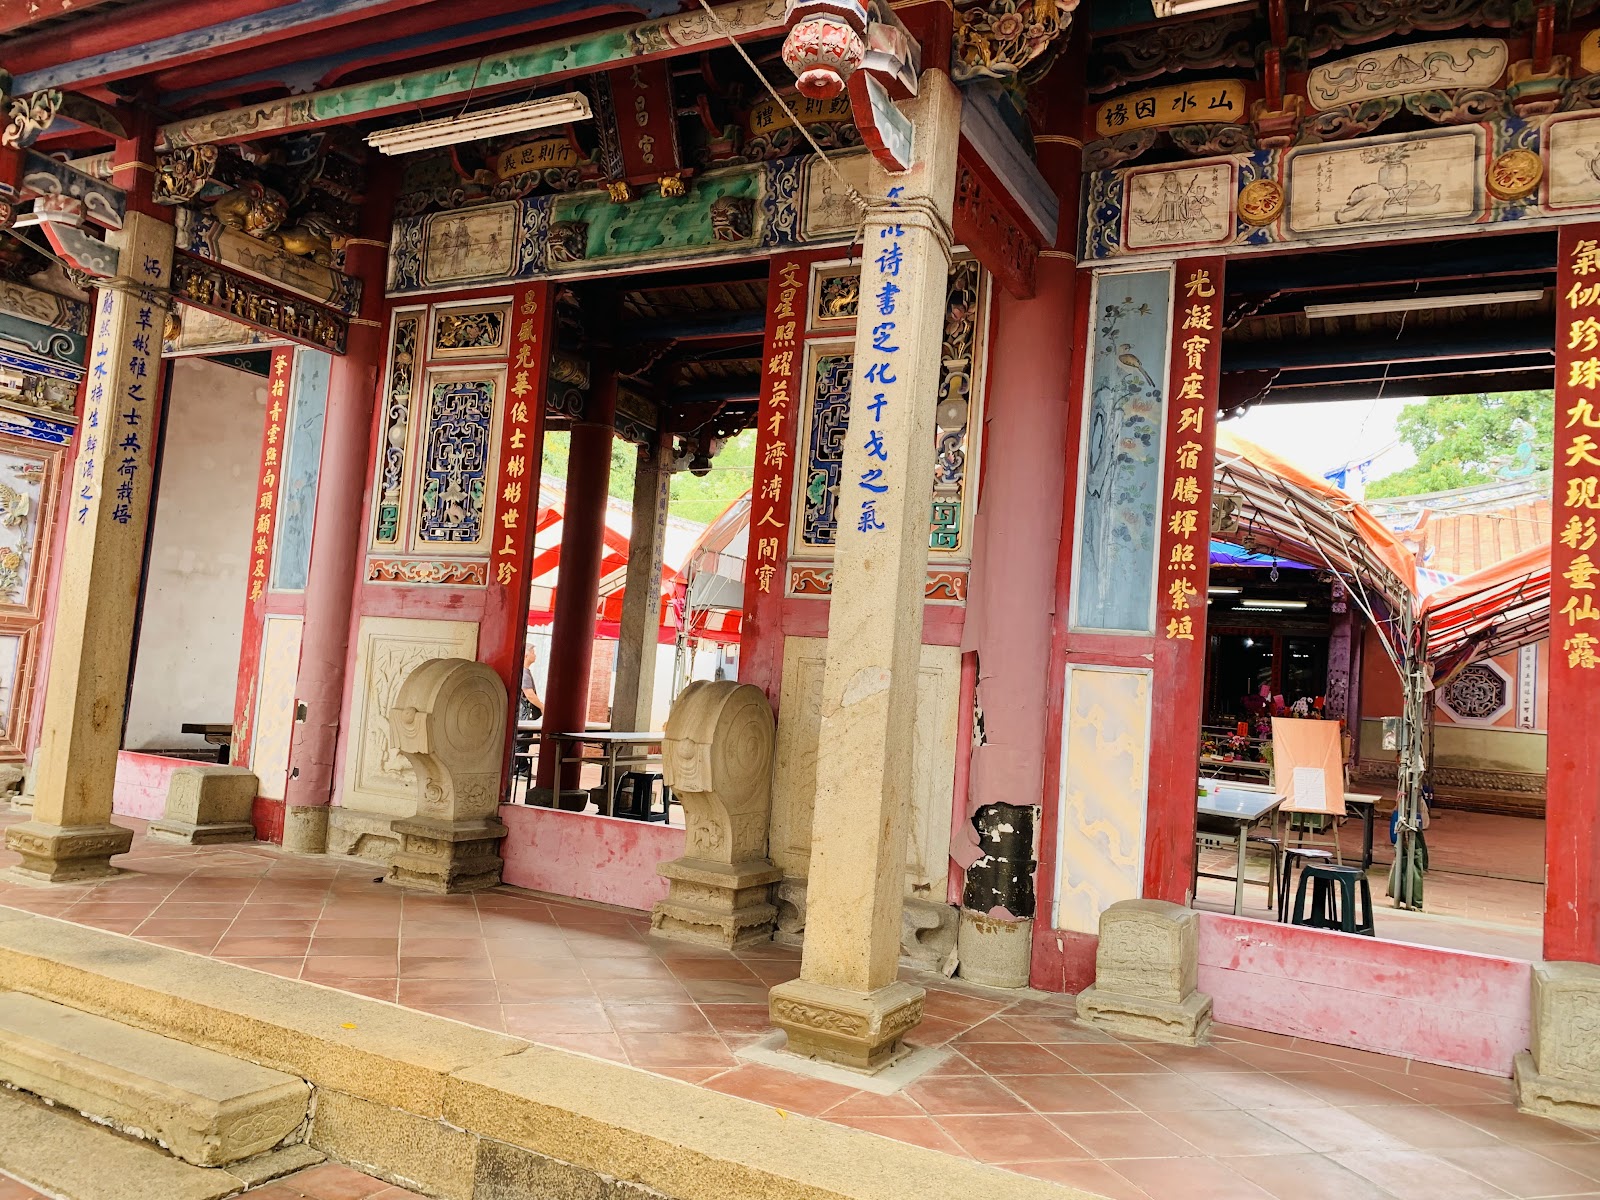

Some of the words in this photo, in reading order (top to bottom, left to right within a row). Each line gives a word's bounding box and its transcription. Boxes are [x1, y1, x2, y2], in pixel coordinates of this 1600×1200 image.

[1105, 90, 1233, 127] 山水因緣
[754, 261, 804, 594] 文星照耀英才濟濟人間寶
[1165, 268, 1216, 641] 光凝寶座列宿騰輝照紫垣
